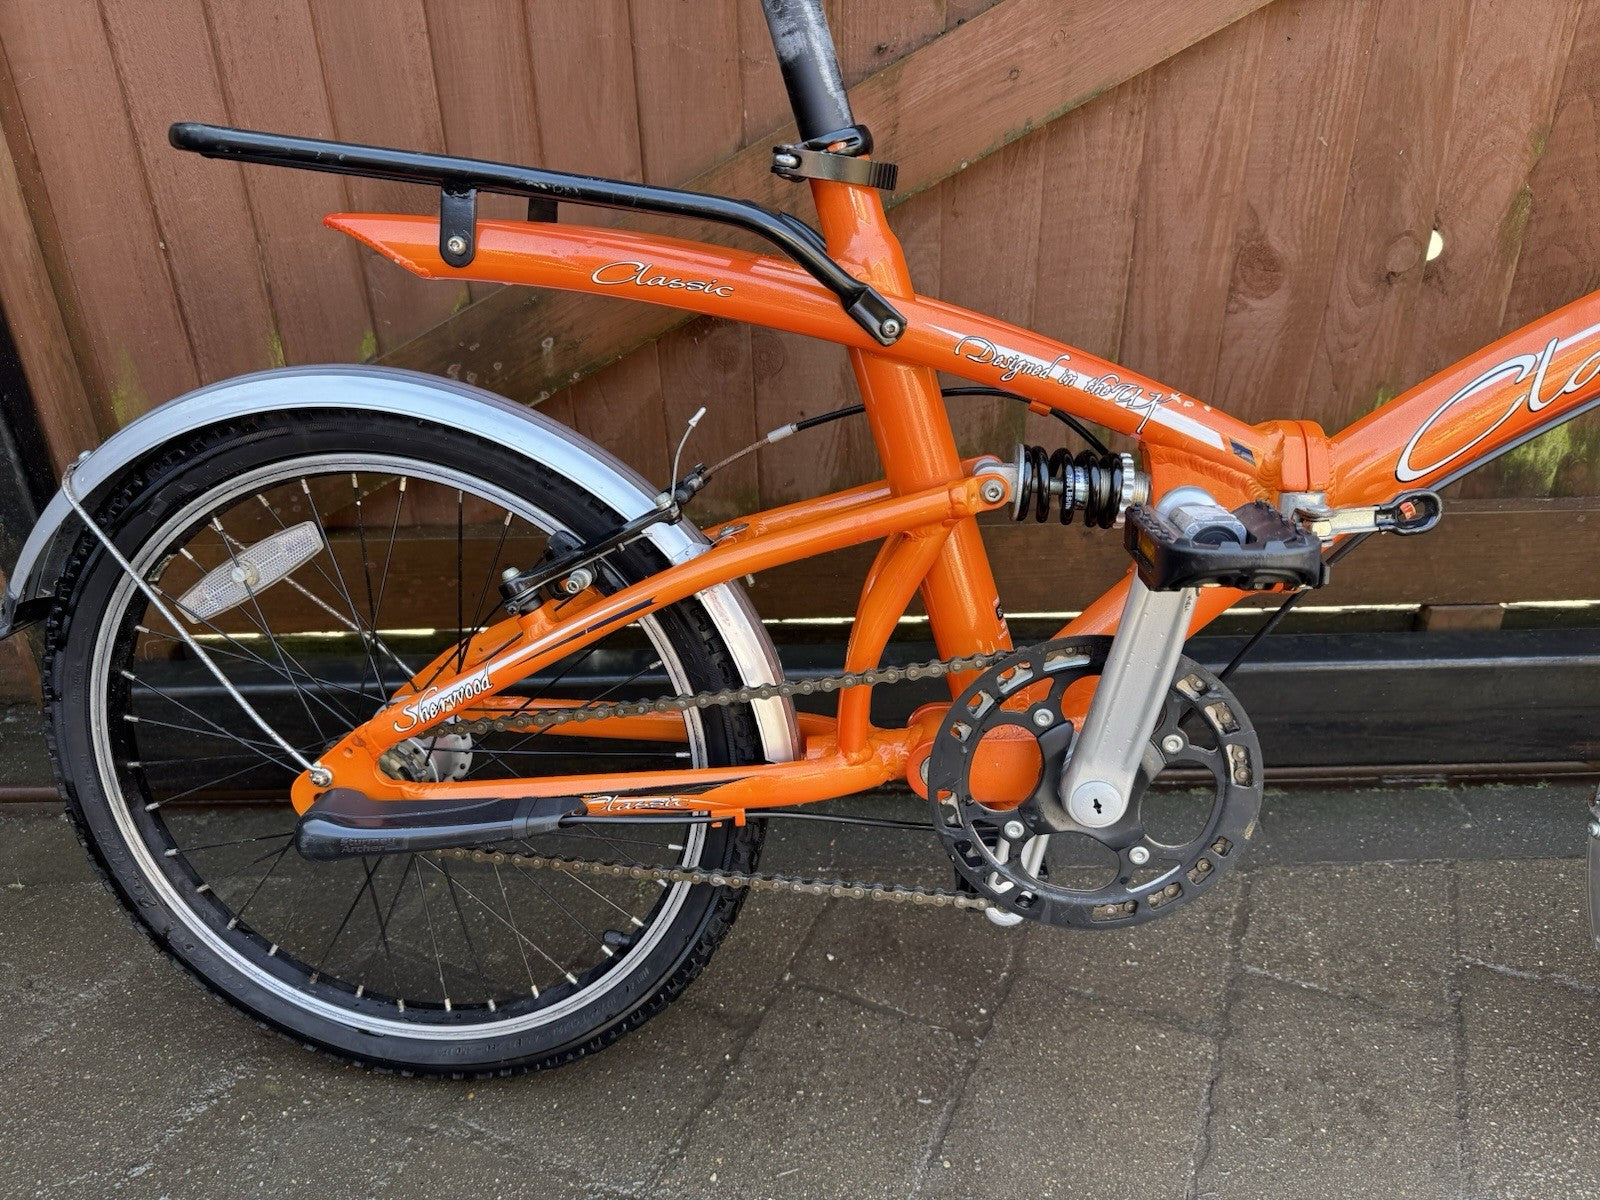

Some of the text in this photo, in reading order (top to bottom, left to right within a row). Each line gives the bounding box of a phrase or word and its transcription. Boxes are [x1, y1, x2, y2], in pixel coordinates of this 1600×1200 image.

[591, 260, 734, 297] Classic
[954, 336, 1070, 381] Designed
[1057, 368, 1079, 387] in
[393, 660, 495, 733] Sherwood
